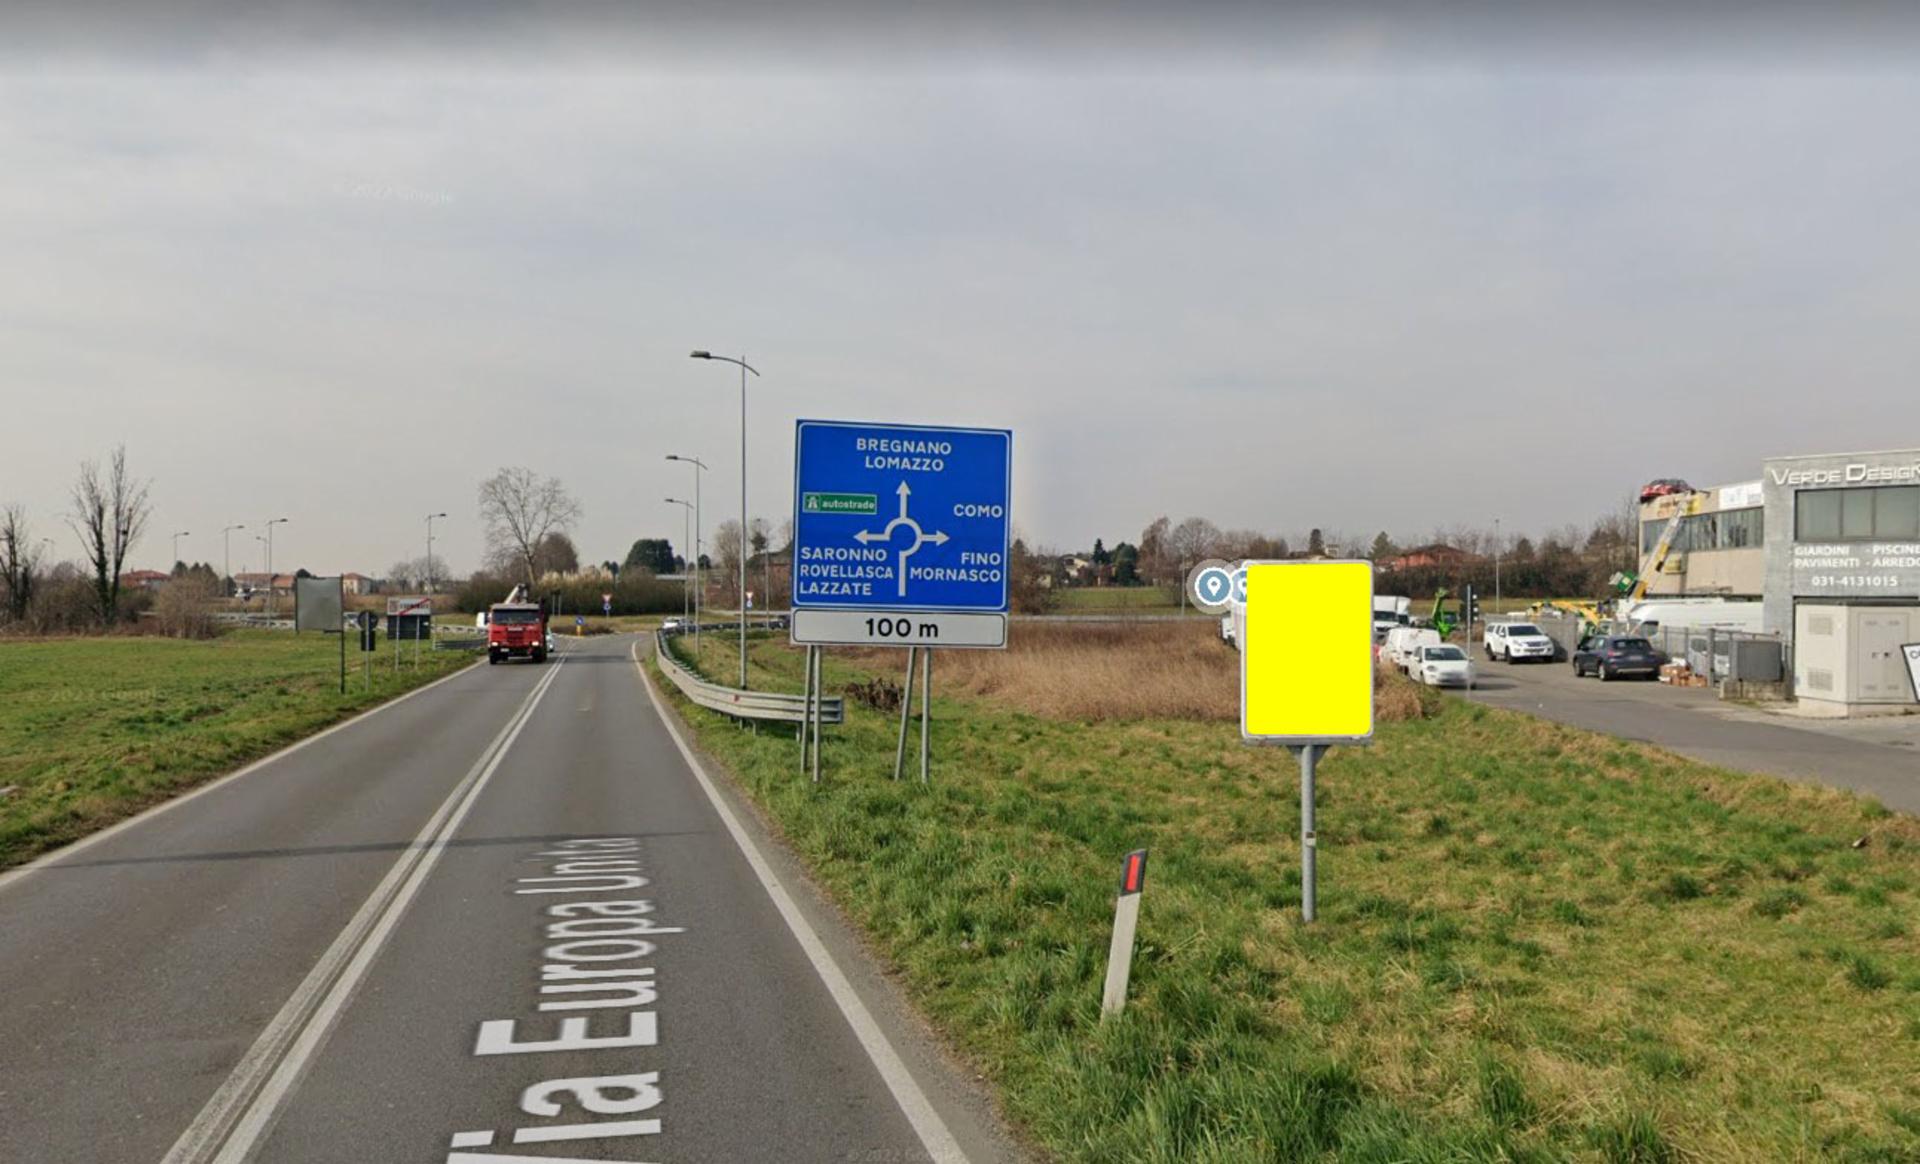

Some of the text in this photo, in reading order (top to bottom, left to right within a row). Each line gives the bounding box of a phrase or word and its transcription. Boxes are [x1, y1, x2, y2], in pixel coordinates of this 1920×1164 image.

[856, 438, 952, 455] BREGNANO
[865, 456, 944, 472] LOMAZZO
[822, 500, 876, 510] autostrade
[953, 504, 1004, 518] COMO
[801, 547, 888, 562] SARONNO
[1794, 545, 1850, 556] GIARDINI
[961, 552, 1001, 566] FINO
[1794, 557, 1860, 568] PAVIMENTI
[800, 564, 894, 580] ROVELLASCA
[910, 567, 1001, 583] MORNASCO
[1811, 576, 1899, 587] 031-4131015
[800, 582, 872, 596] LAZZATE
[866, 618, 938, 638] 100 m
